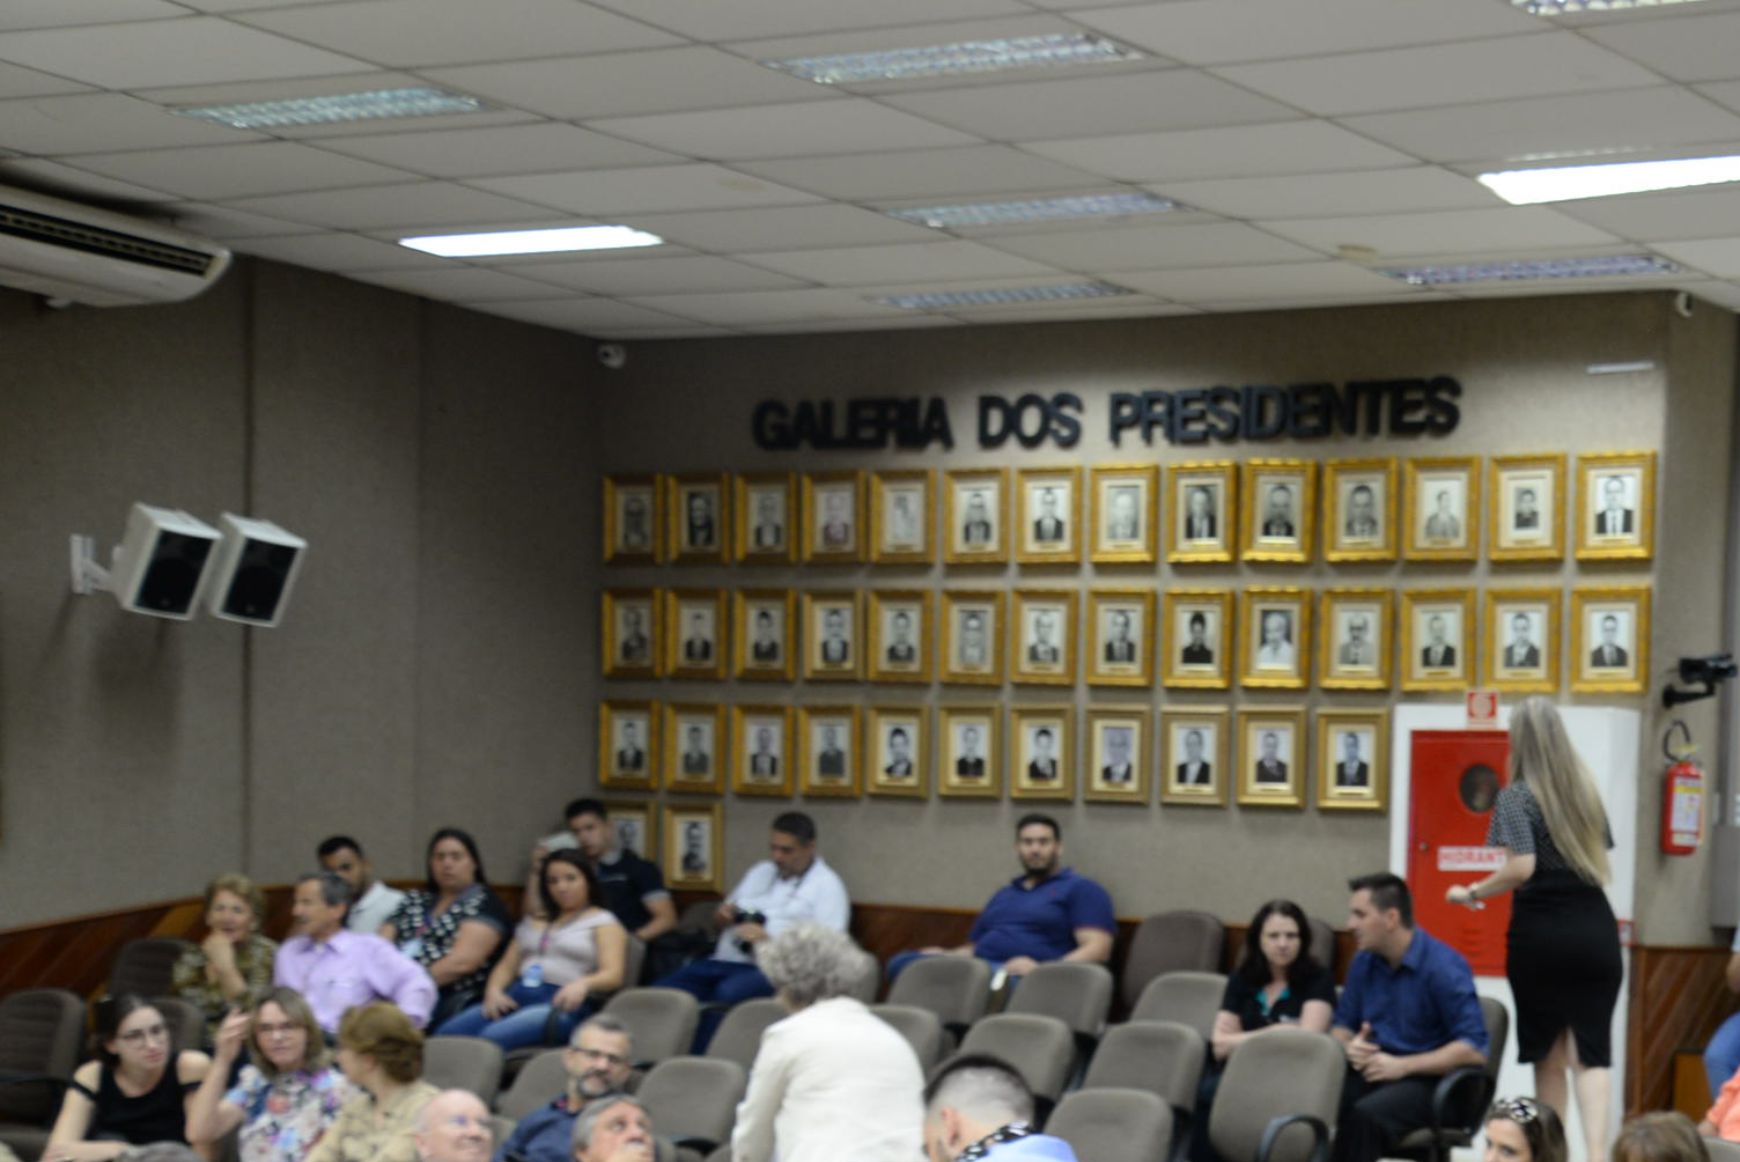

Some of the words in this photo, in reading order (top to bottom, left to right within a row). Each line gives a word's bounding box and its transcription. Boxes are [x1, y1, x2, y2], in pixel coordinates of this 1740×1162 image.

[751, 396, 954, 451] GALERIA
[977, 394, 1083, 449] DOS
[1108, 376, 1463, 449] PRESIDENTES
